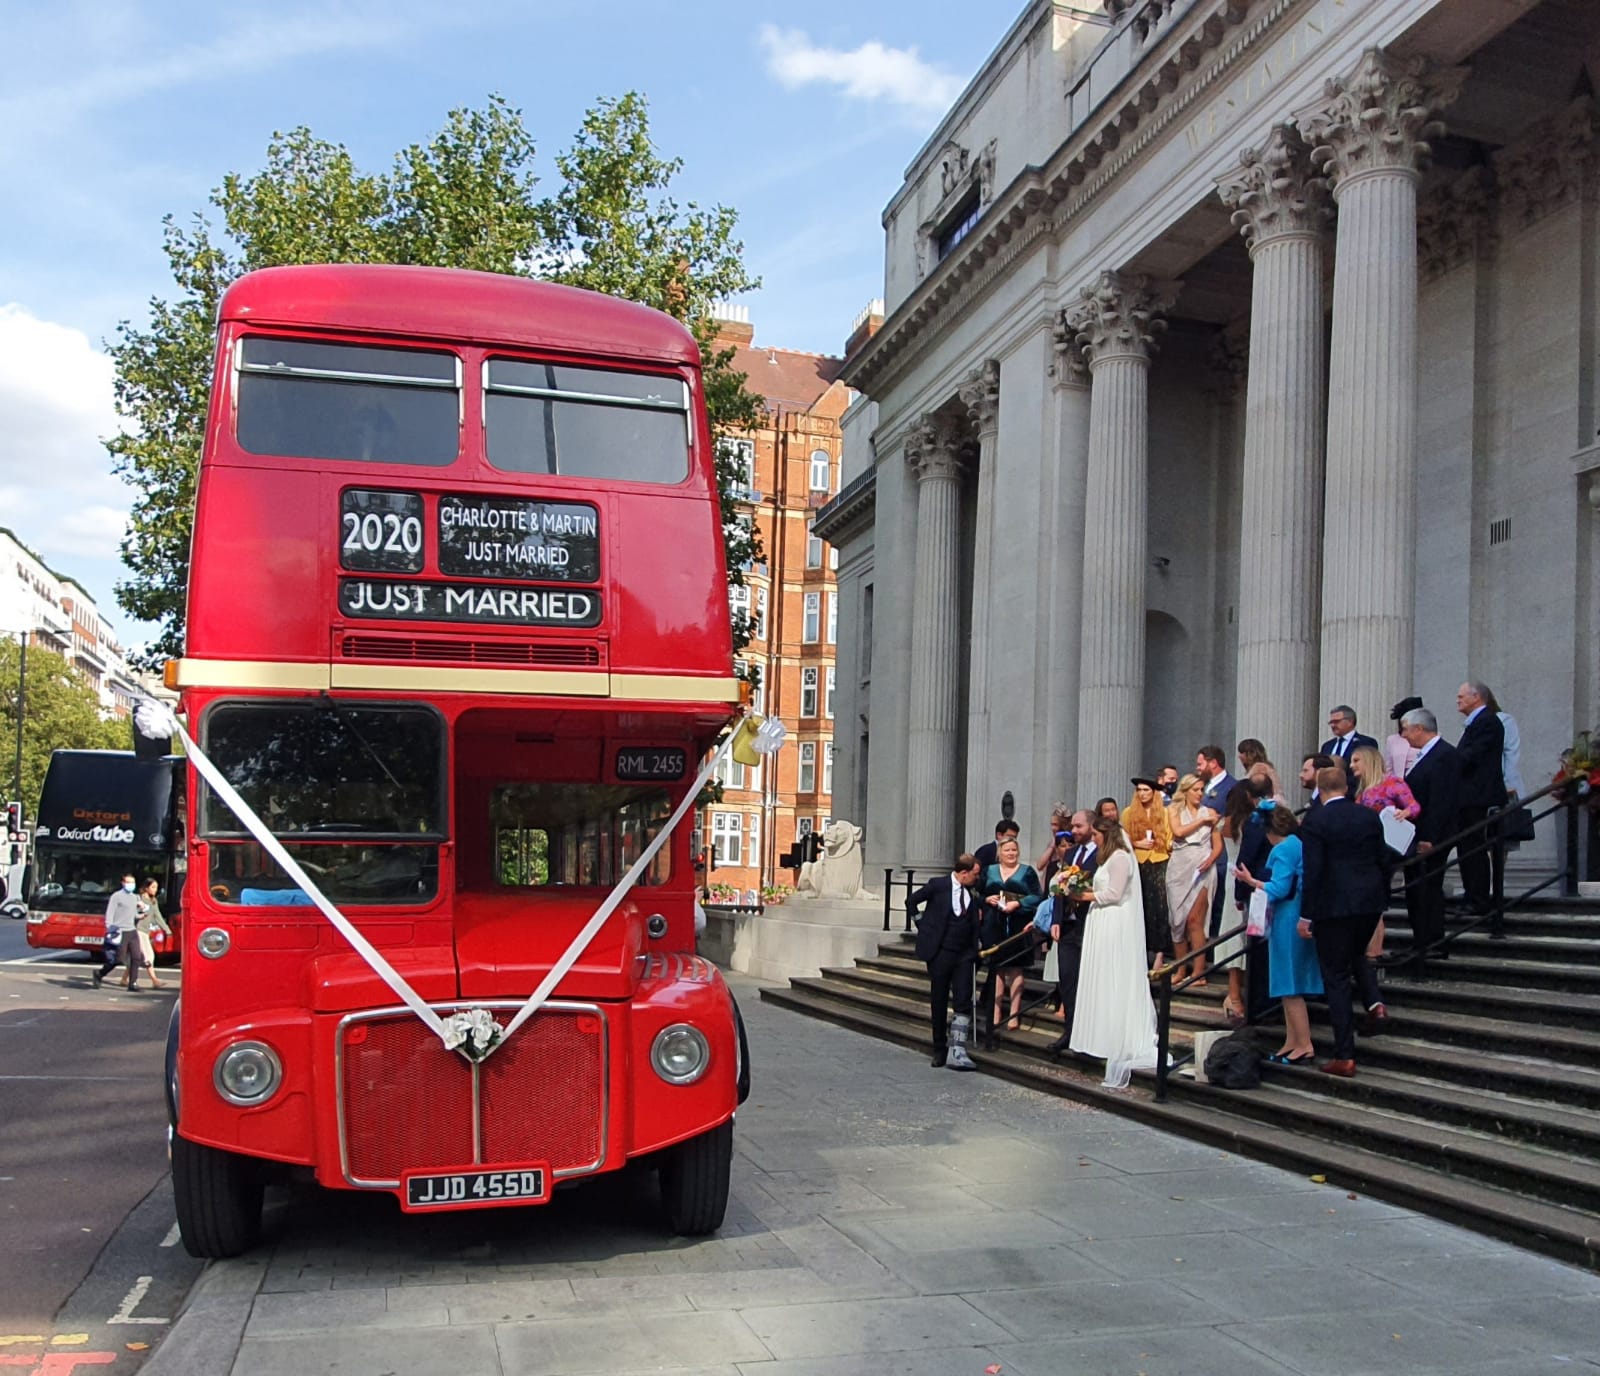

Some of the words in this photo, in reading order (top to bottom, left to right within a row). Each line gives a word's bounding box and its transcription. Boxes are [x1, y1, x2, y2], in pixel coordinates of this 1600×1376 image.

[343, 512, 422, 553] 2020
[440, 507, 526, 531] CHARLOTTE
[531, 514, 539, 531] &
[543, 514, 596, 538] MARTIN
[464, 542, 502, 562] JUST
[506, 544, 569, 566] MARRIED
[349, 583, 431, 613] JUST
[445, 587, 591, 619] MARRIED
[617, 755, 649, 774] RML
[652, 755, 684, 774] 2455
[418, 1177, 466, 1201] JJD
[472, 1172, 535, 1197] 455D
